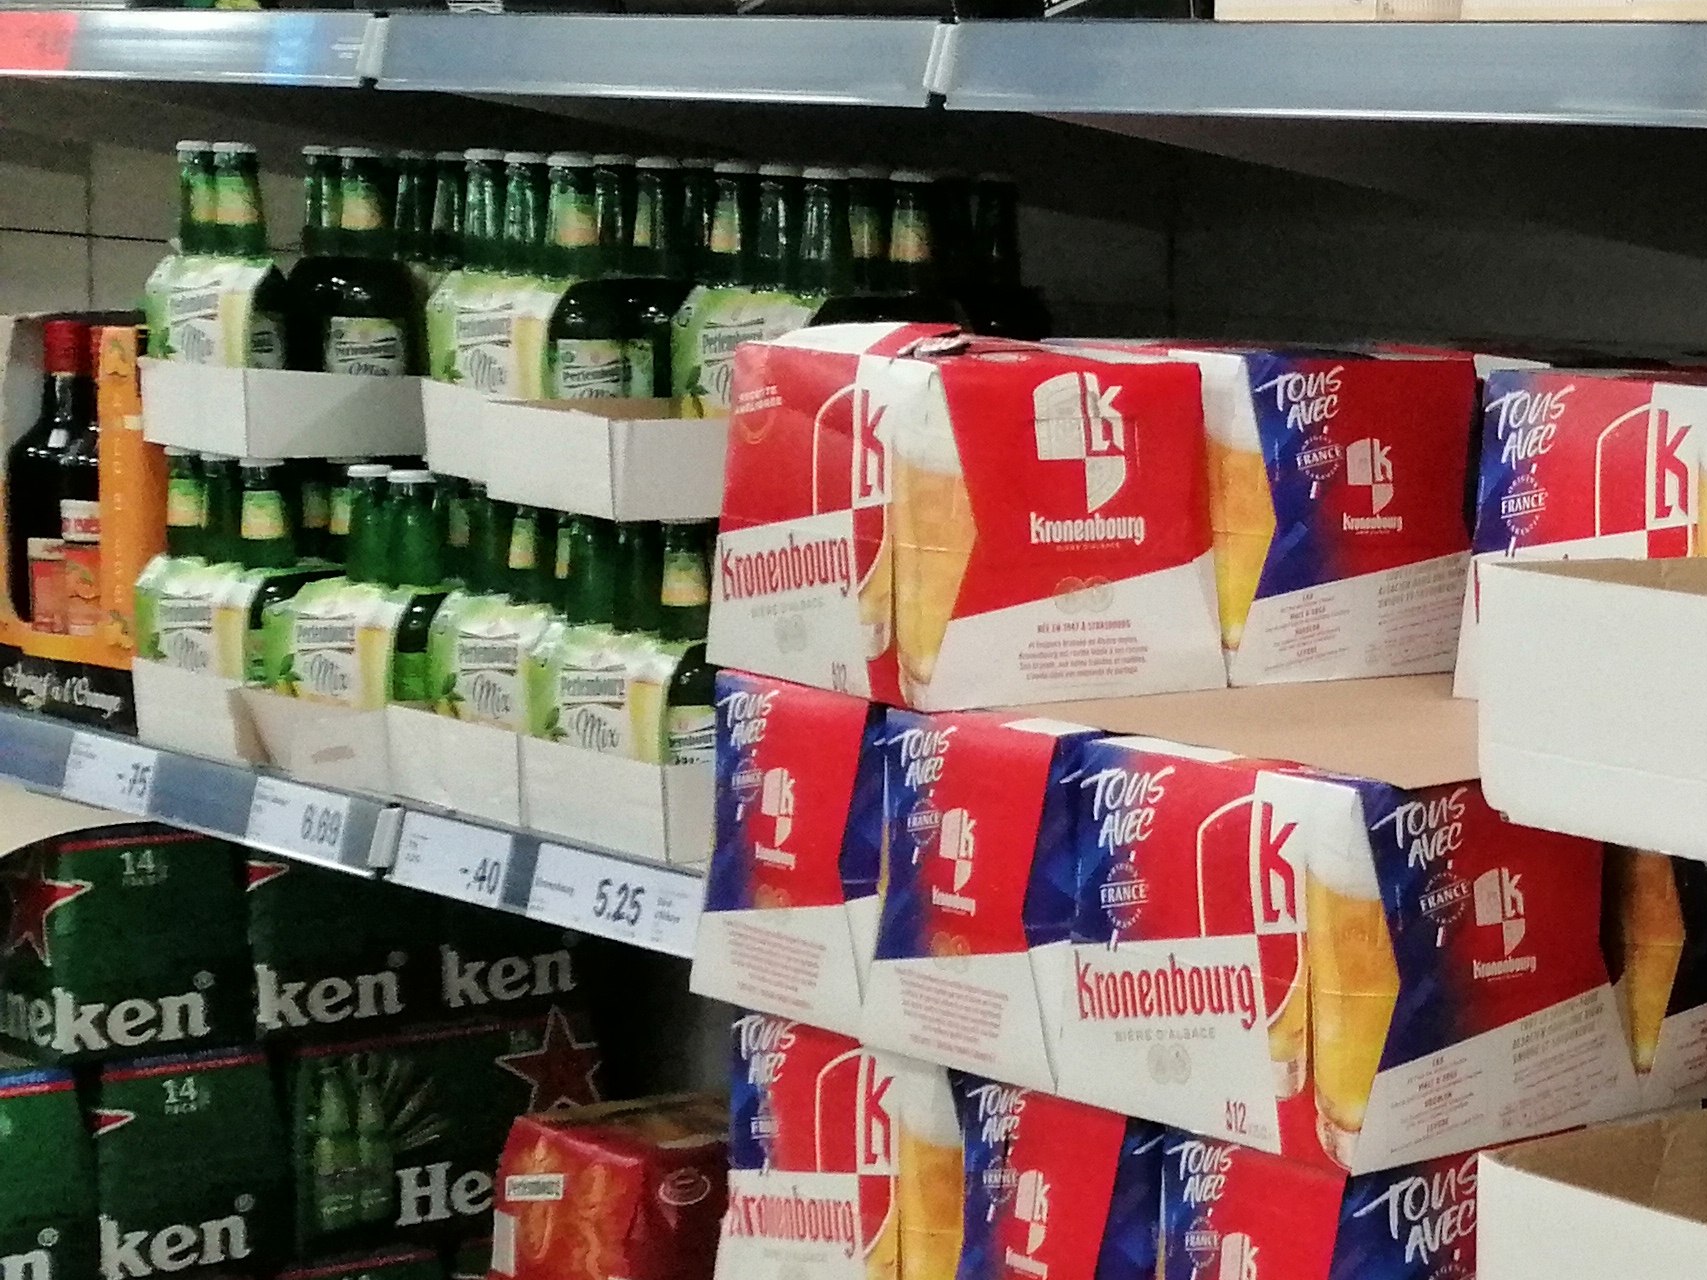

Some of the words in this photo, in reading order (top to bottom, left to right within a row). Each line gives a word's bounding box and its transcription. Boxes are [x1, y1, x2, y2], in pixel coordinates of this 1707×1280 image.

[1254, 366, 1344, 411] TOUS
[1286, 394, 1339, 433] AVEC
[1485, 385, 1575, 440] TOUS
[1296, 444, 1344, 468] FRANCE
[1502, 423, 1556, 463] AVEC
[1501, 491, 1546, 514] FRANCE
[1029, 513, 1144, 545] Kronenbourg
[720, 533, 851, 602] Kronenbourg
[905, 755, 944, 790] AVEC
[1079, 766, 1174, 821] TOUS
[1098, 807, 1155, 856] AVEC
[1371, 788, 1468, 848] TOUS
[120, 851, 152, 875] 14
[1408, 824, 1464, 870] AVEC
[593, 878, 645, 926] 5.25
[1101, 882, 1149, 904] FRANCE
[1420, 879, 1470, 910] FRANCE
[1074, 949, 1257, 1030] Kronenbourg
[728, 1185, 856, 1259] Kronenbourg
